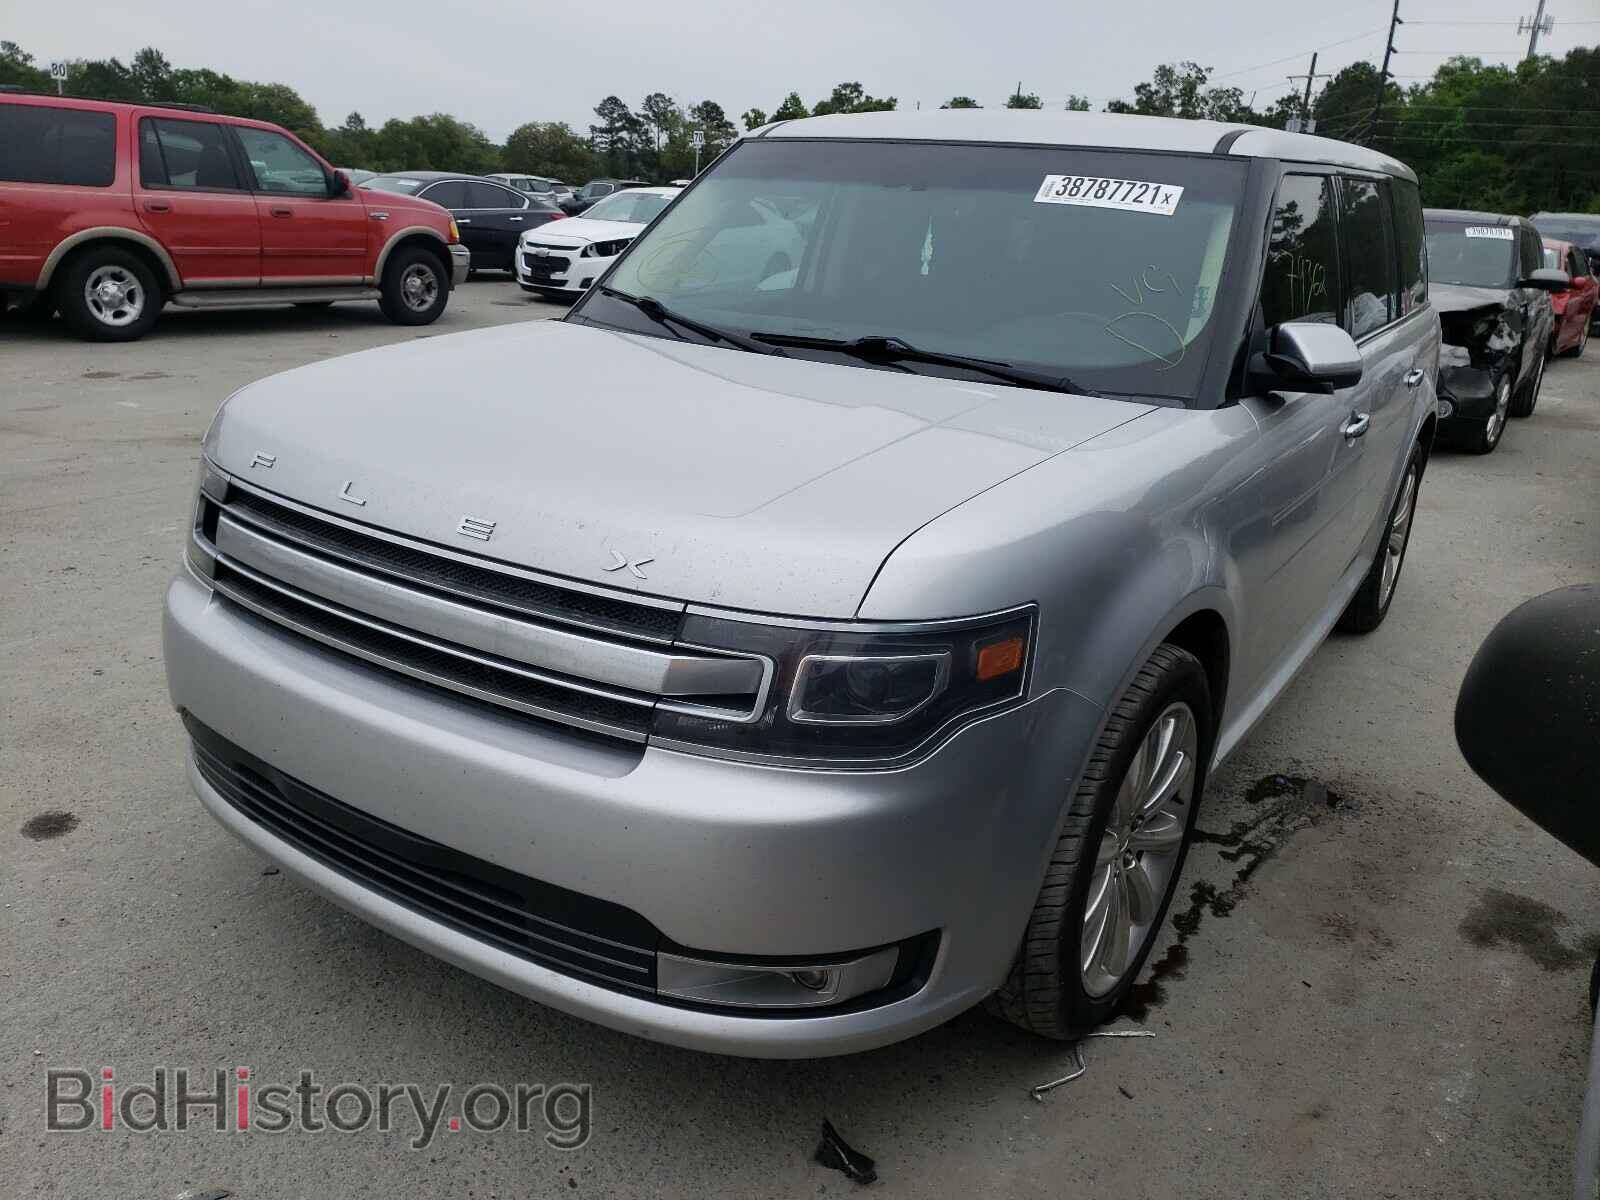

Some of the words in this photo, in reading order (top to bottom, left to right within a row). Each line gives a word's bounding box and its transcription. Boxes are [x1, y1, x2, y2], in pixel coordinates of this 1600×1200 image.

[51, 63, 66, 77] 80
[694, 132, 703, 143] 70
[1055, 176, 1162, 205] 38787721
[249, 450, 655, 580] FLEX
